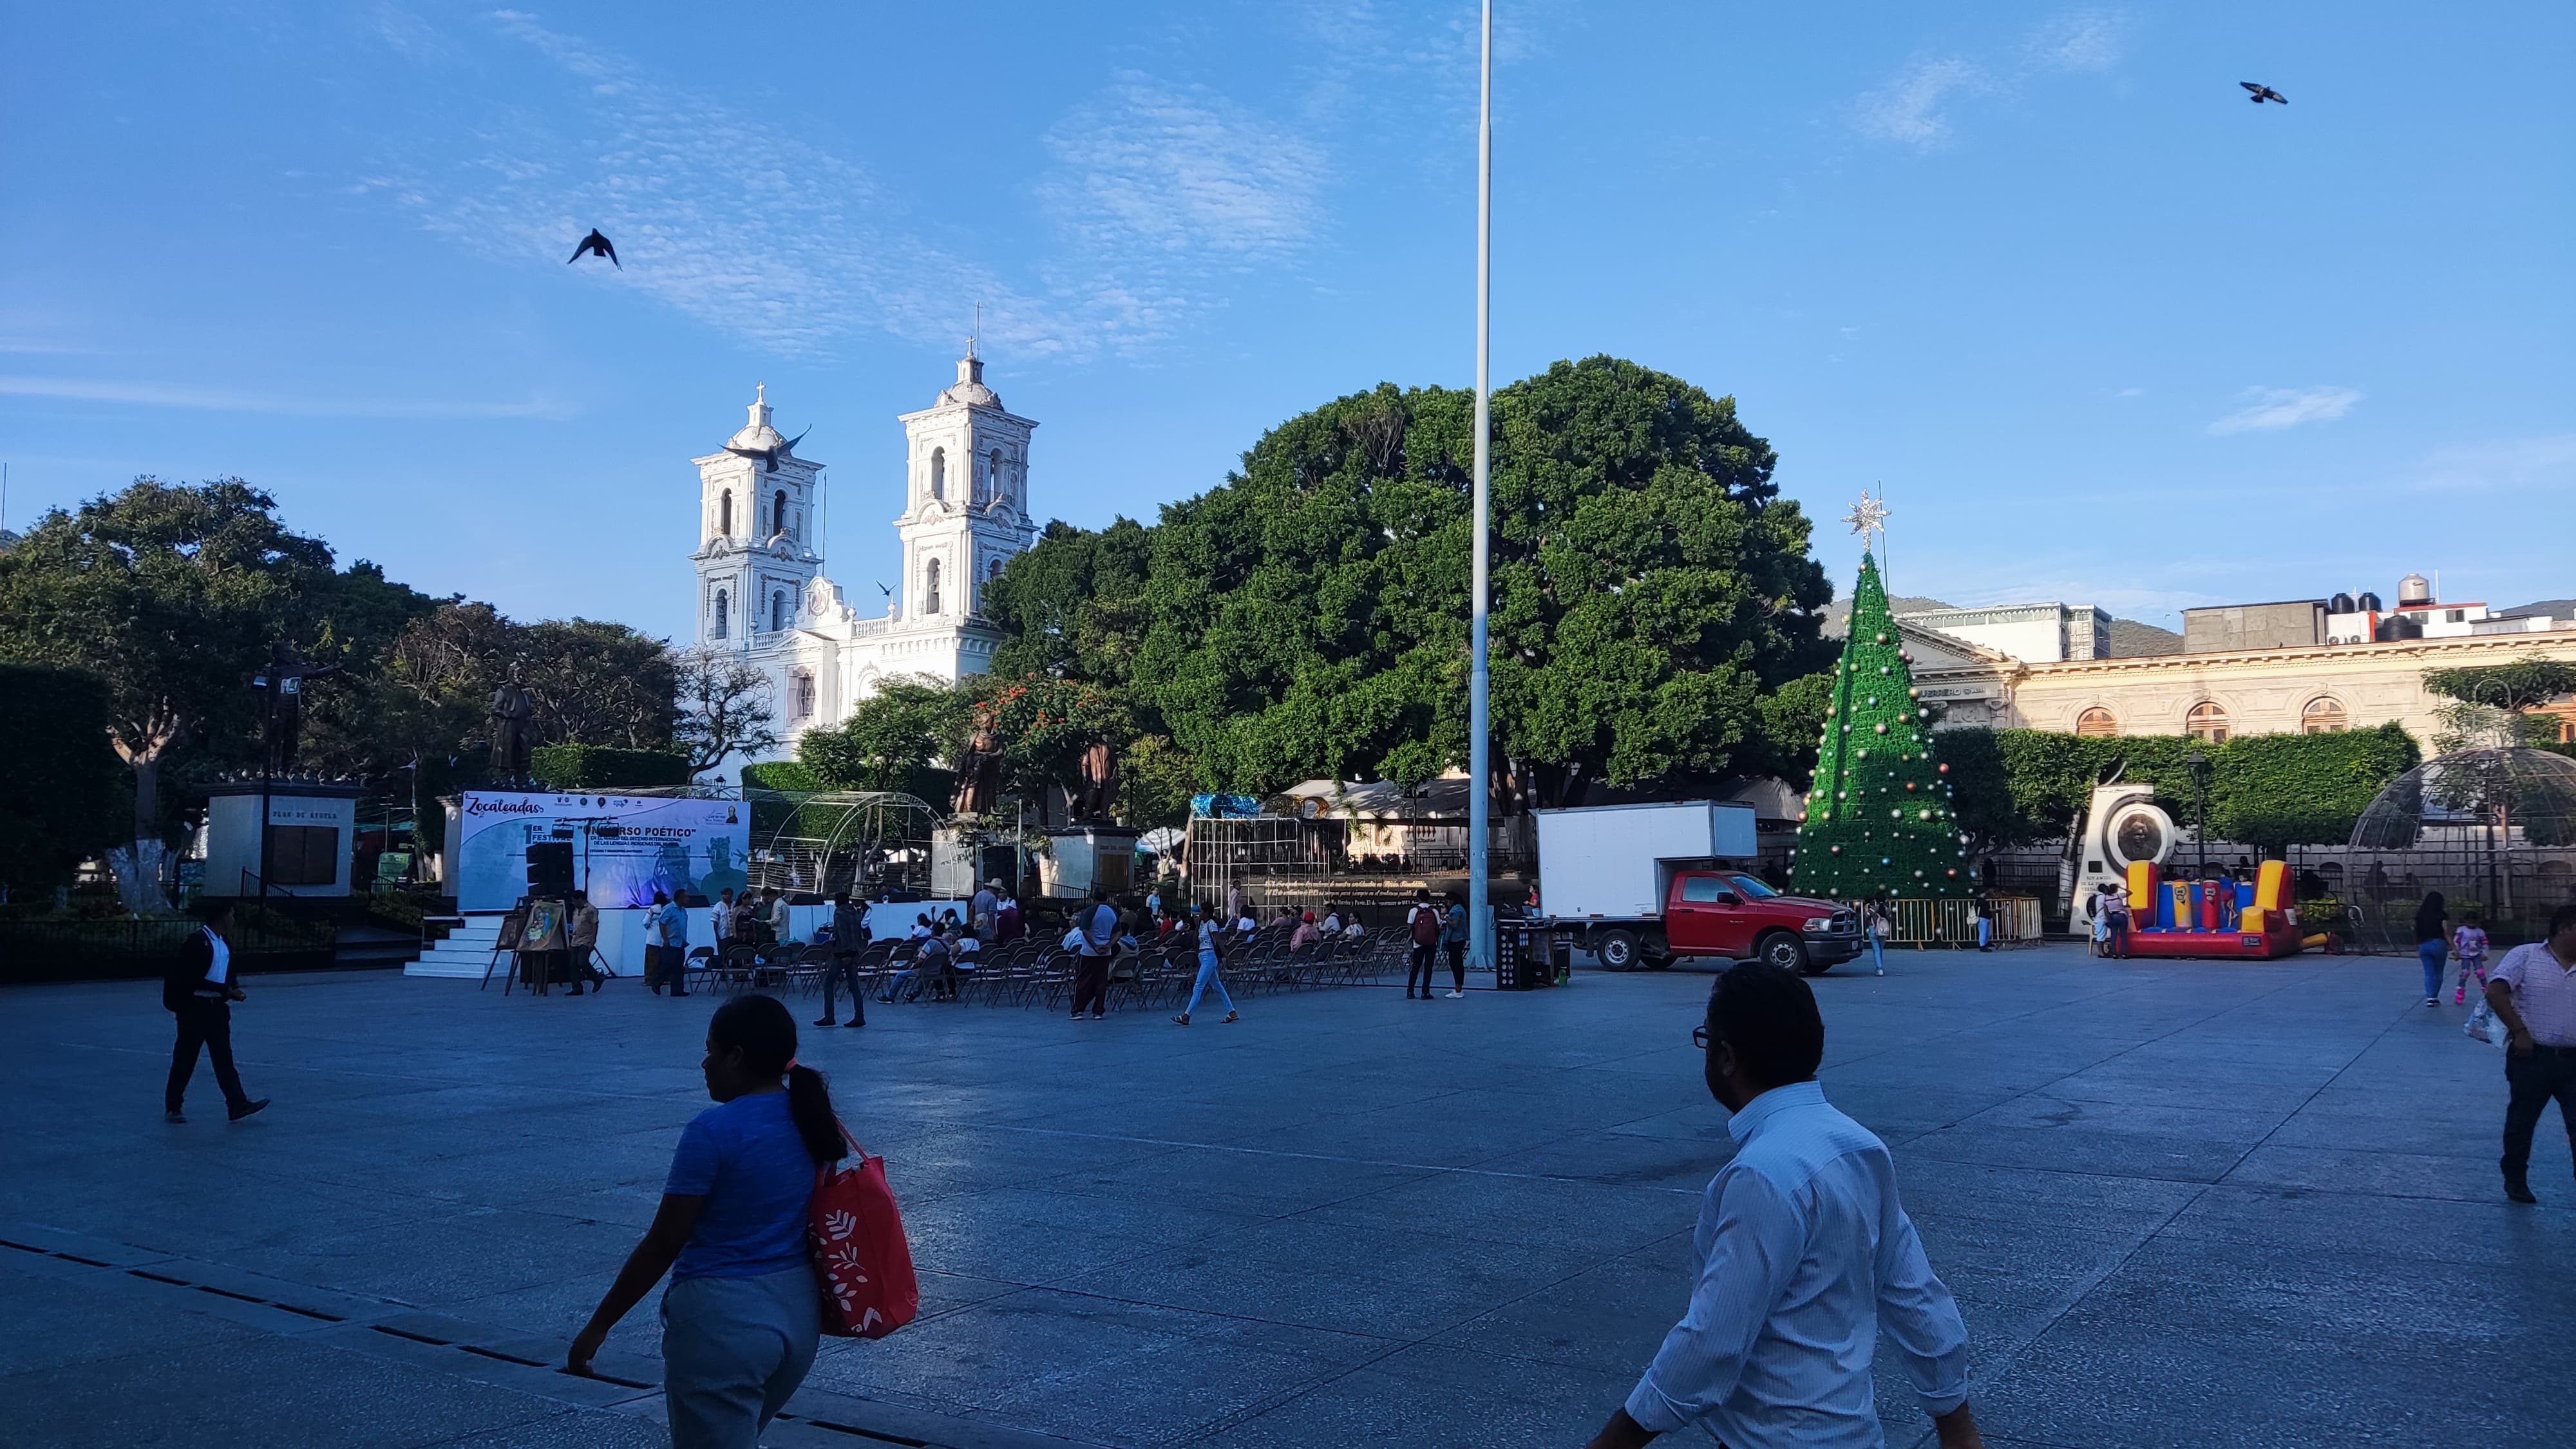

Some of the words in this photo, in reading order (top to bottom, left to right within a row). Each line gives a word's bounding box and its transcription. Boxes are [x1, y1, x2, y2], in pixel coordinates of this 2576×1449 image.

[1920, 687, 1962, 697] UERRERO
[465, 793, 544, 816] Zocaleadas
[577, 826, 641, 837] "UNRSO
